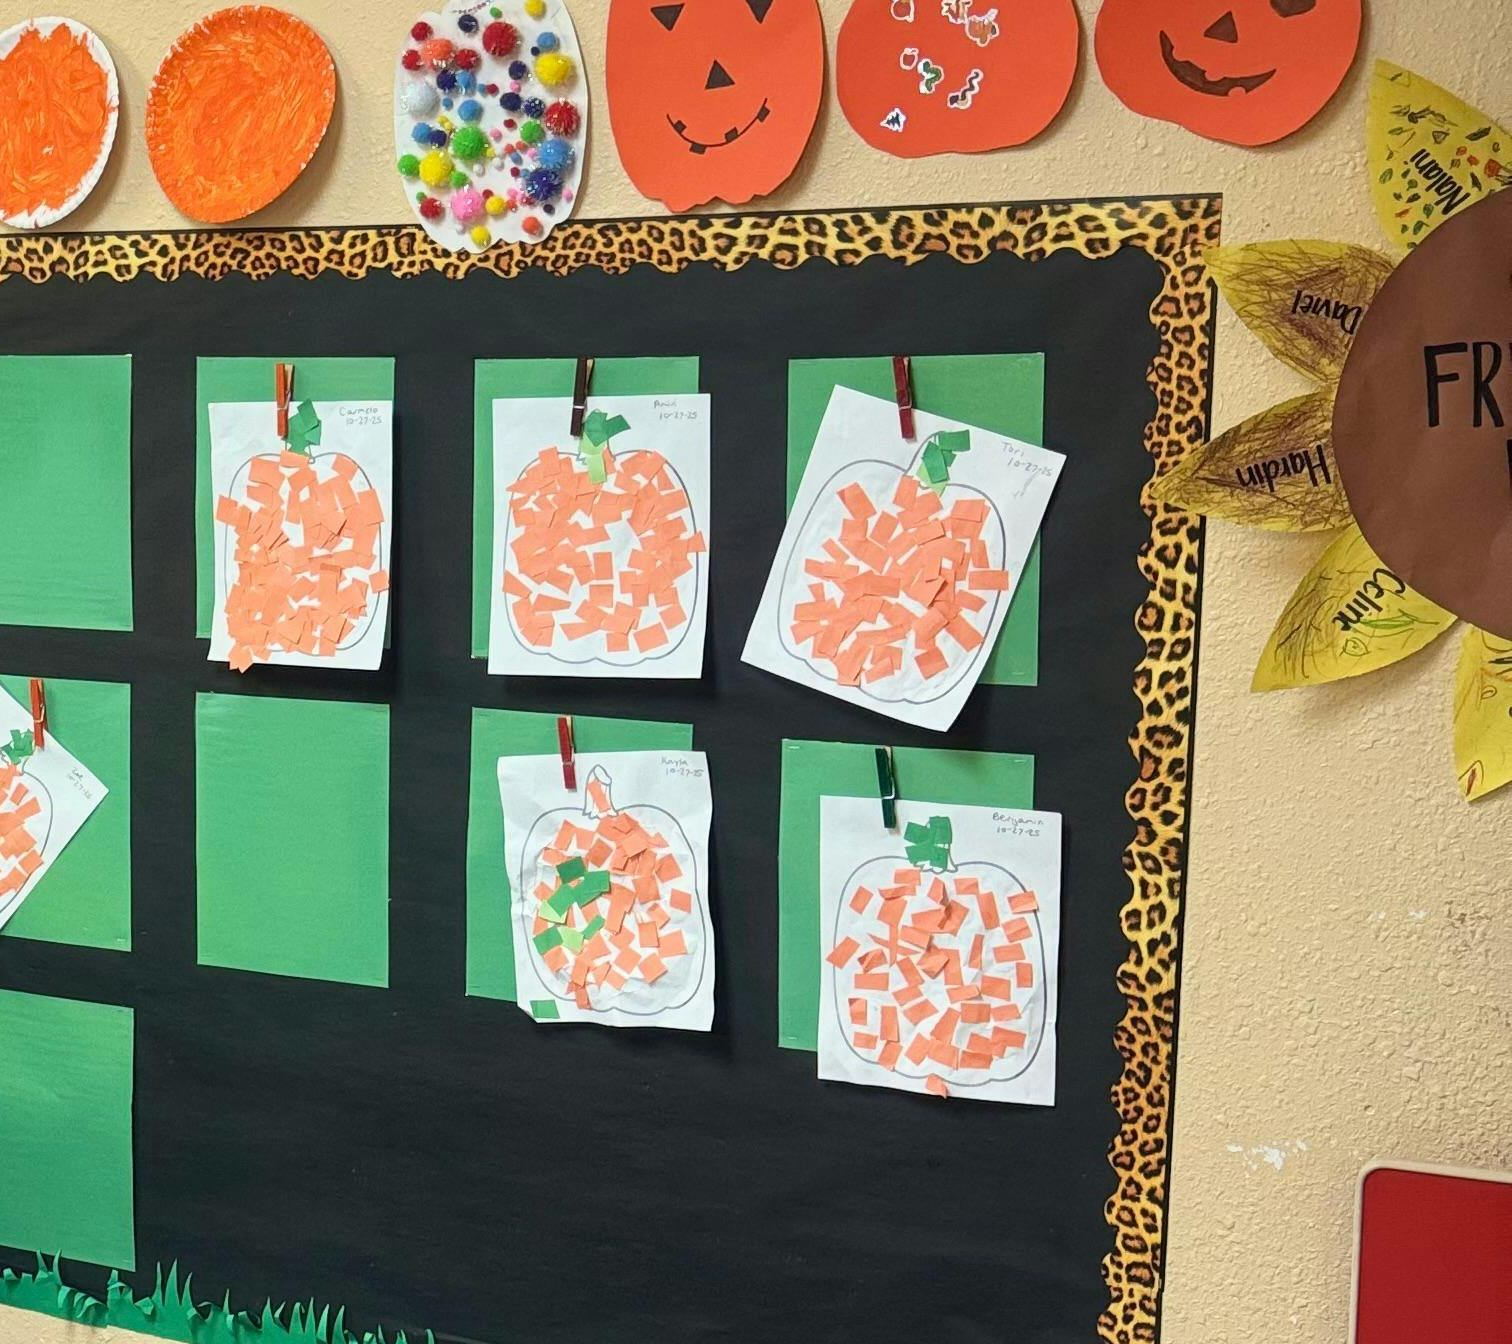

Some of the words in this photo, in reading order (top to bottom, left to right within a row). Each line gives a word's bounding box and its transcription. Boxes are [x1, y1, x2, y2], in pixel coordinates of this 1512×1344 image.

[1403, 148, 1471, 216] Nalani
[1423, 340, 1512, 429] FR
[1235, 444, 1332, 494] Hardin
[1331, 566, 1407, 632] Celine
